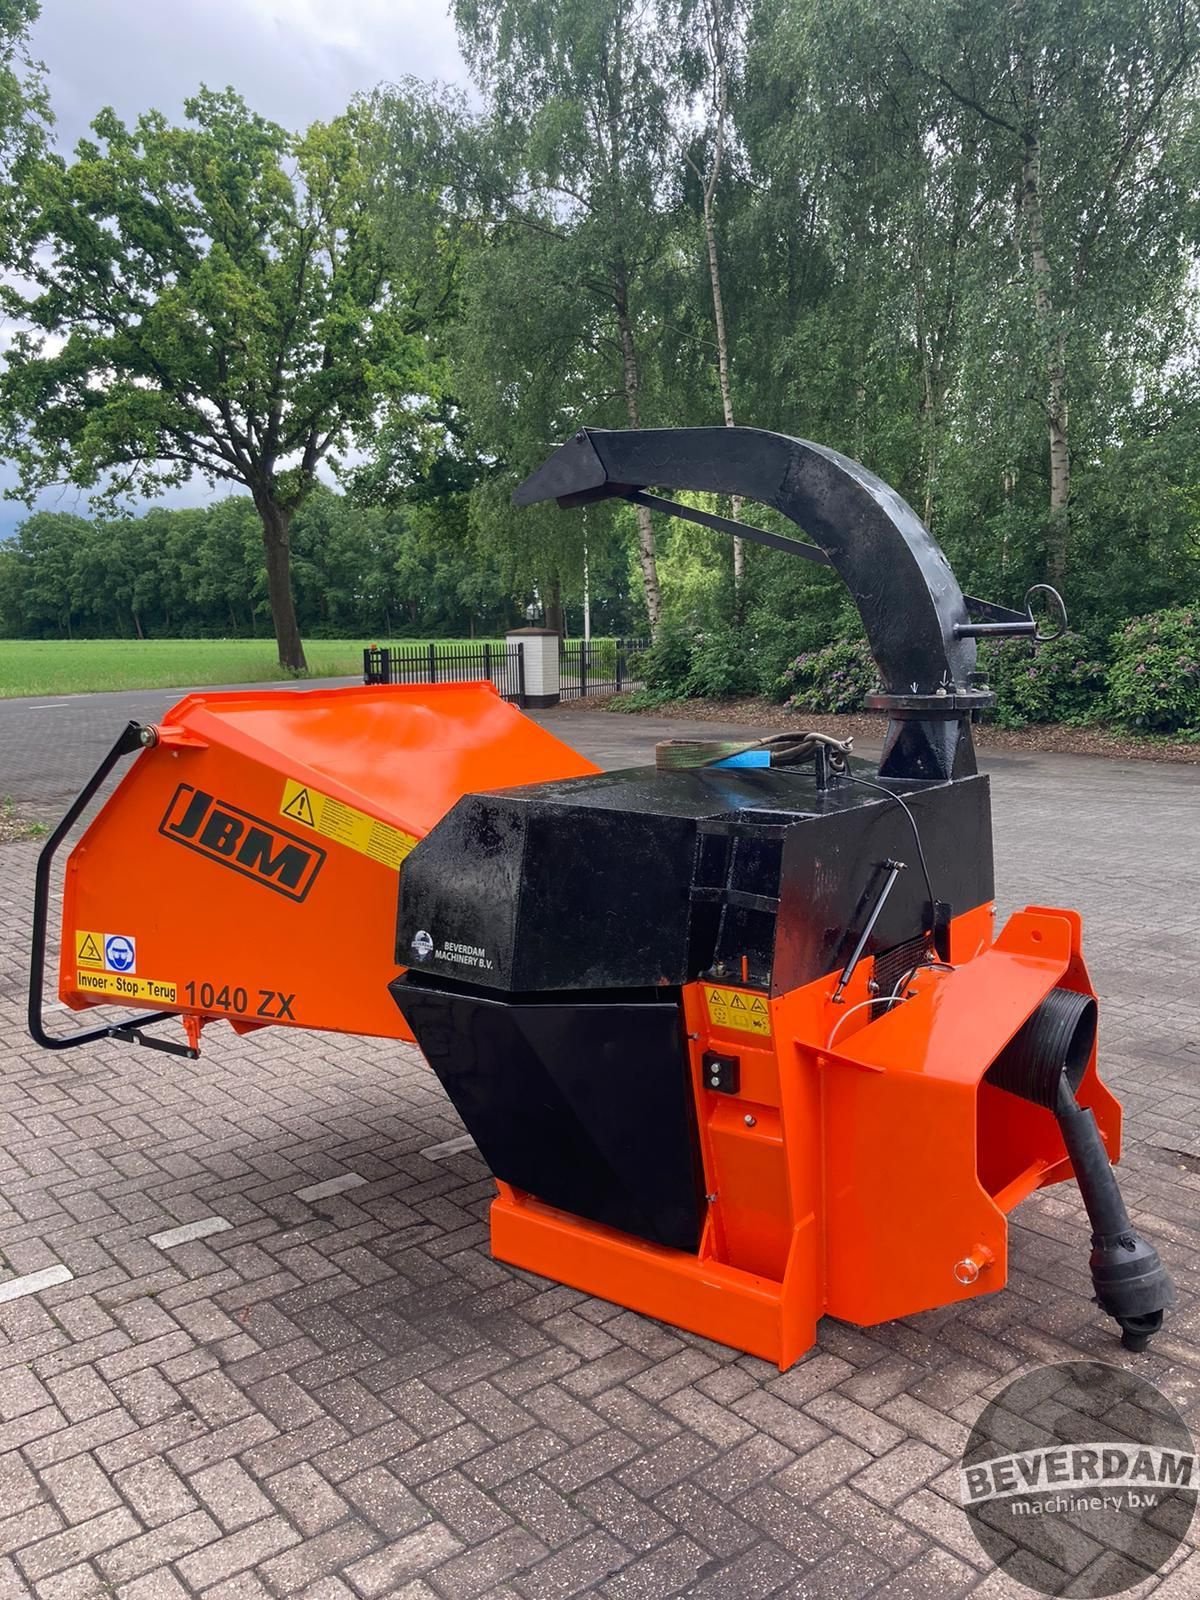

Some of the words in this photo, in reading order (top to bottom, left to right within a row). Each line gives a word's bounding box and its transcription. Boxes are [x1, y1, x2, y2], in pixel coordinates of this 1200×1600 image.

[169, 789, 312, 890] JBM
[434, 950, 479, 966] MACHINERY
[479, 958, 494, 970] B.V.
[444, 941, 485, 957] BEVERDAM
[78, 972, 107, 988] Invoer
[116, 977, 139, 996] Stop
[147, 981, 176, 1002] Terug
[185, 981, 248, 1013] 1040
[257, 990, 296, 1020] ZX
